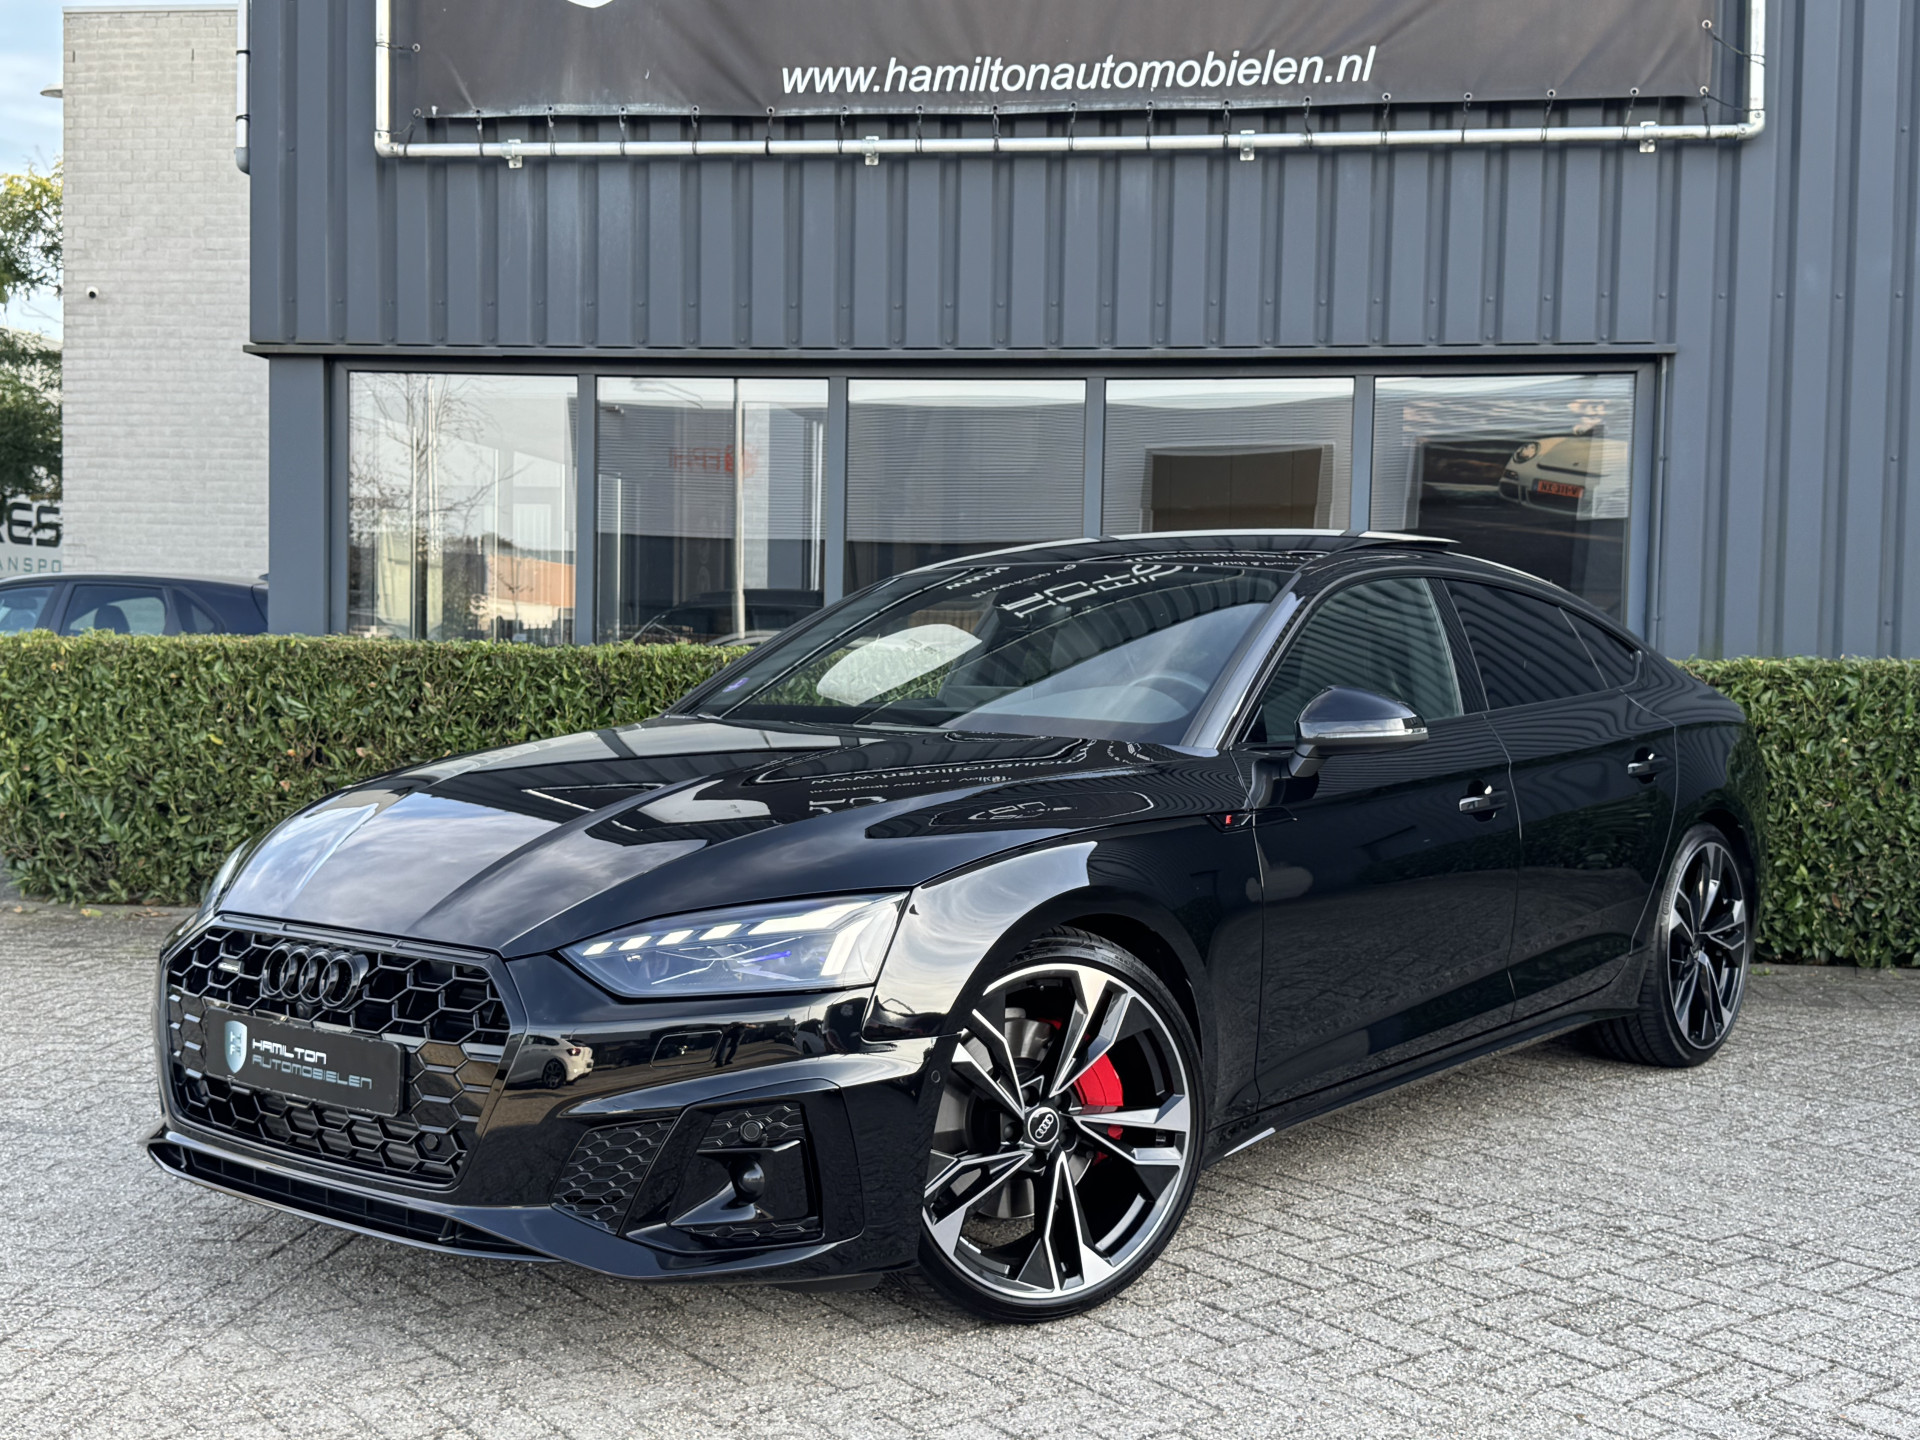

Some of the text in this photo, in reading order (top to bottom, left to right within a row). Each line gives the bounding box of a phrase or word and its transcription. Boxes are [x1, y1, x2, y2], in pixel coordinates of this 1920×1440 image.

[781, 45, 1377, 94] www.hamiltonautomobielen.nl
[0, 501, 62, 549] ES
[252, 1038, 327, 1065] HAMILTON
[252, 1054, 373, 1090] AUTOMOBIELEN
